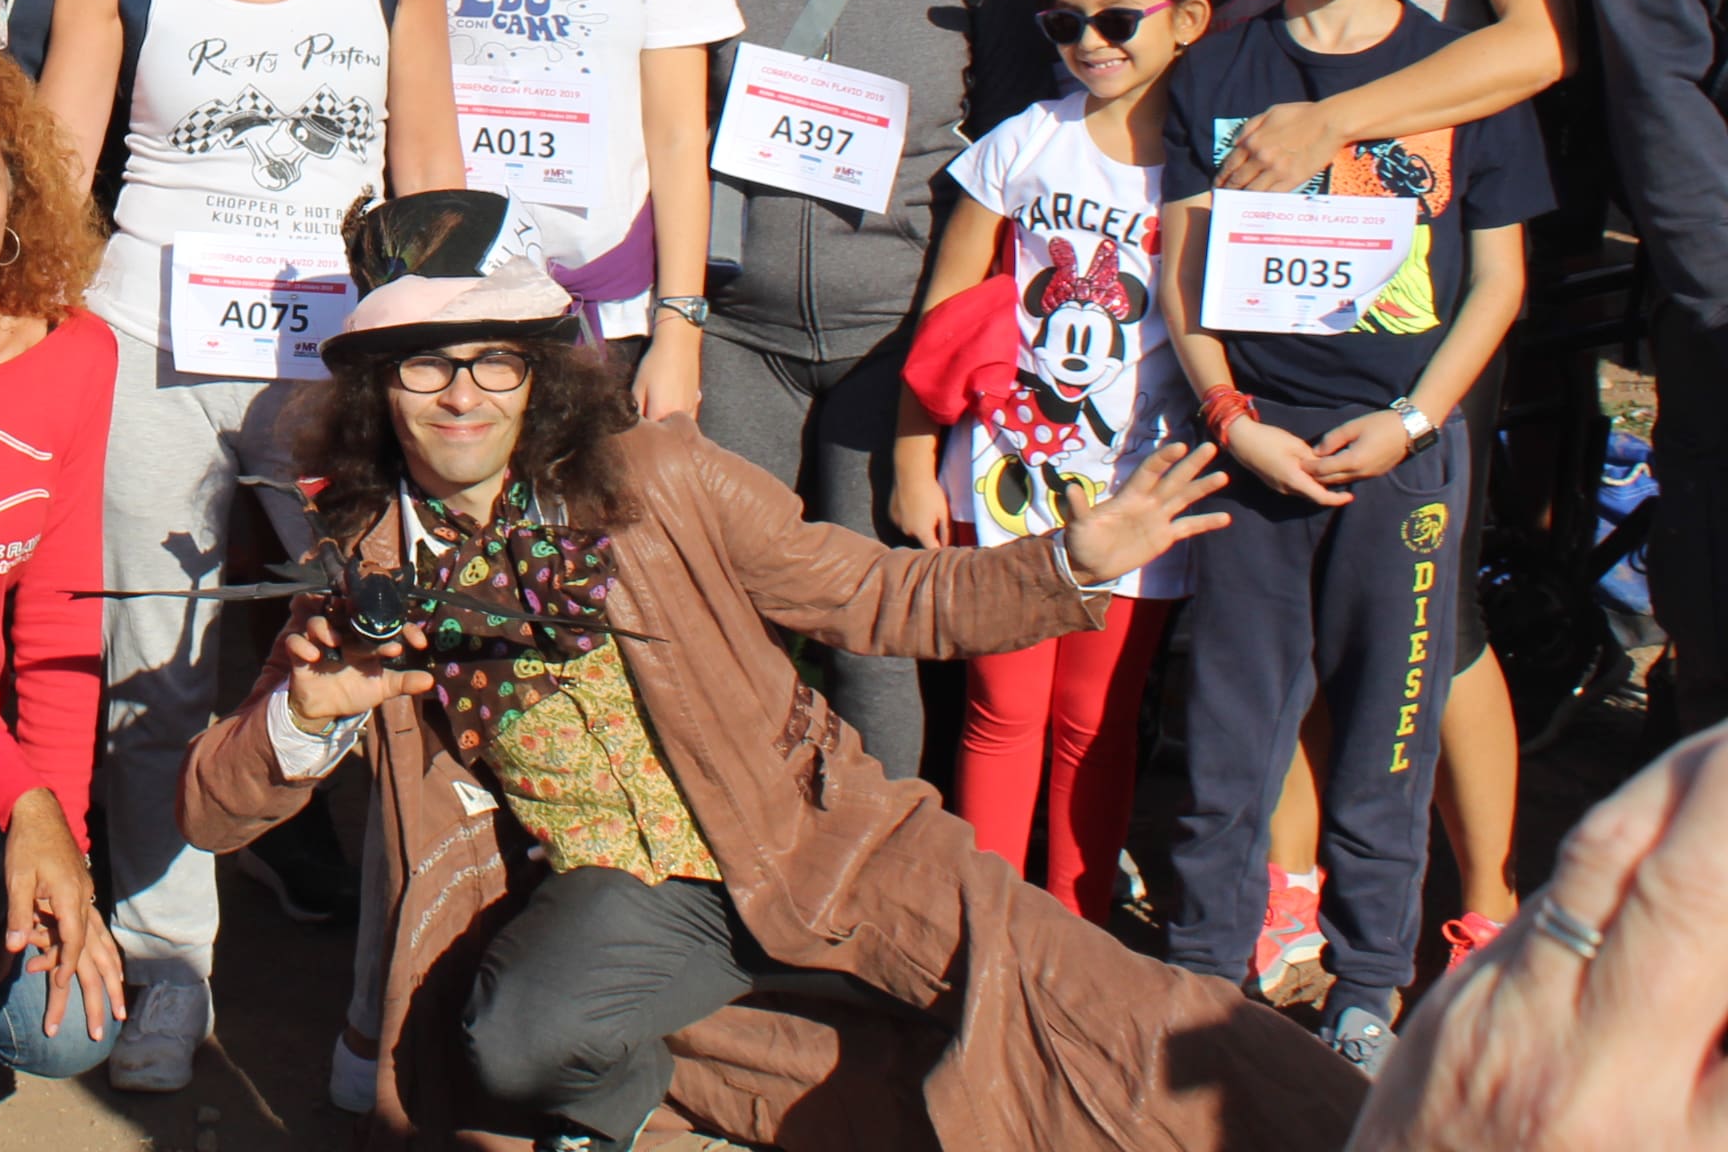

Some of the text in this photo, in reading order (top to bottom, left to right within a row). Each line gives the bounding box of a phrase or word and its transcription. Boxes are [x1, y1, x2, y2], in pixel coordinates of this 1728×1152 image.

[456, 13, 571, 42] CONI CAMP
[523, 87, 555, 96] FLAVIO
[472, 127, 555, 159] A013
[770, 115, 854, 156] A397
[206, 195, 277, 214] CHOPPER
[304, 206, 330, 218] HOT
[212, 211, 280, 230] KUSTOM
[292, 223, 342, 235] KULTU
[1263, 256, 1352, 289] B035
[220, 301, 309, 332] A075
[1390, 561, 1434, 773] DIESEL
